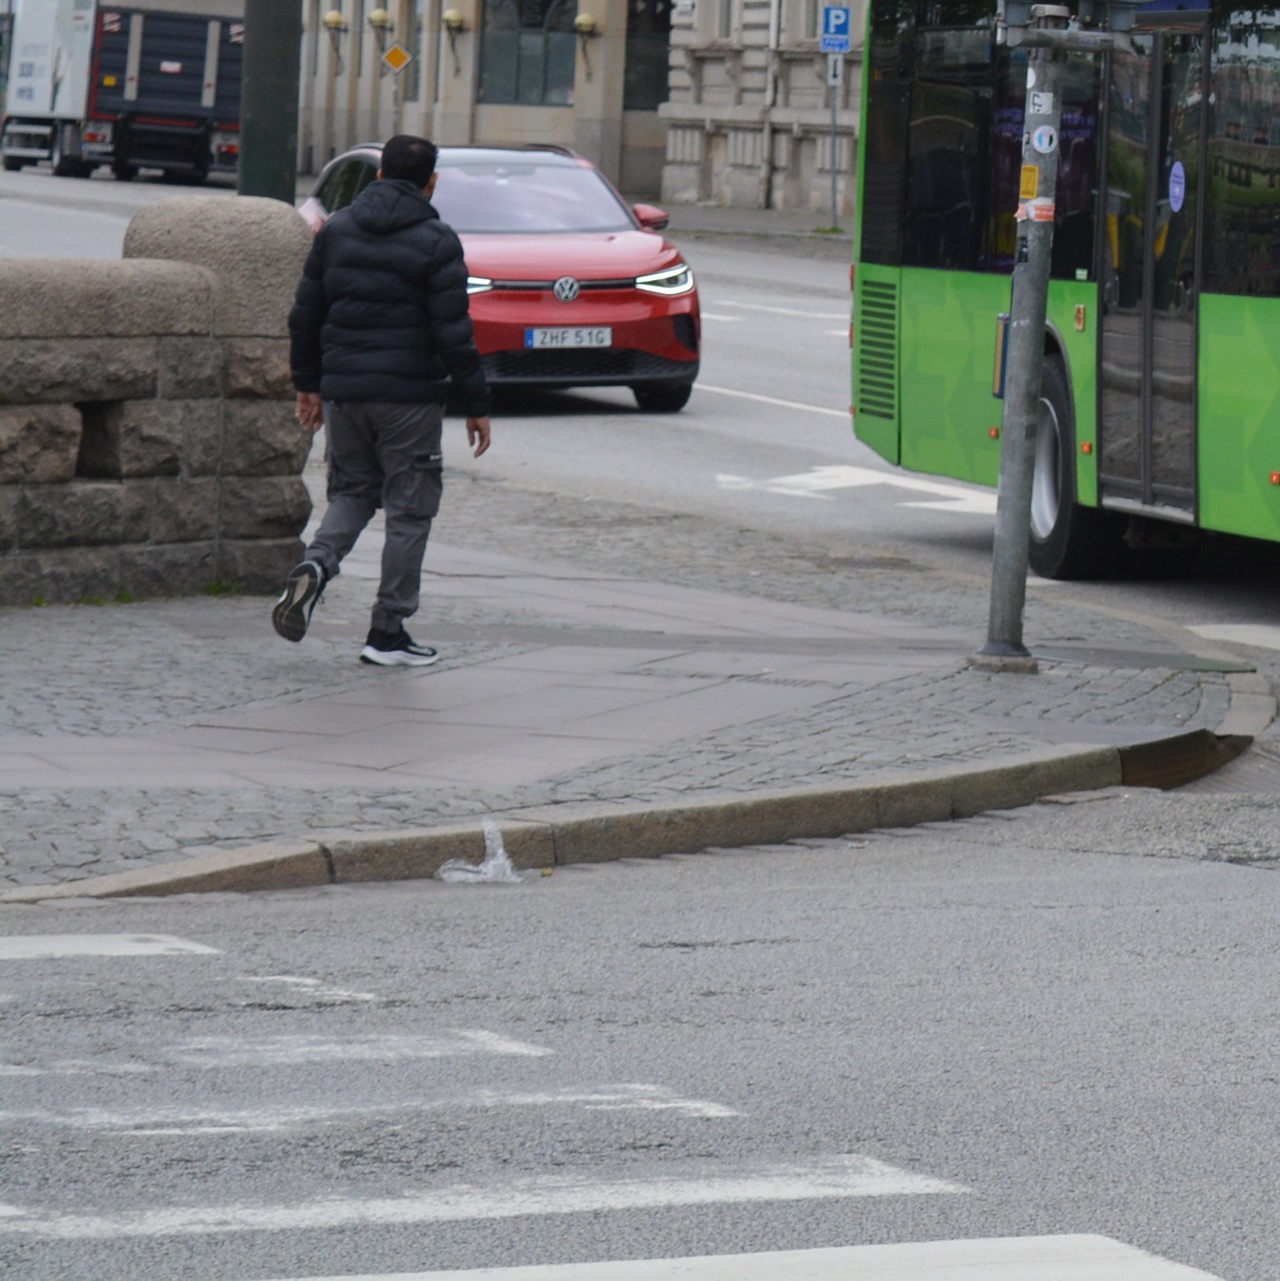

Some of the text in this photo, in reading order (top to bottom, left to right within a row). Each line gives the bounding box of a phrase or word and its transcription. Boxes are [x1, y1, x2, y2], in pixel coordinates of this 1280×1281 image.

[829, 9, 846, 34] P
[540, 329, 605, 345] ZHF 51G
